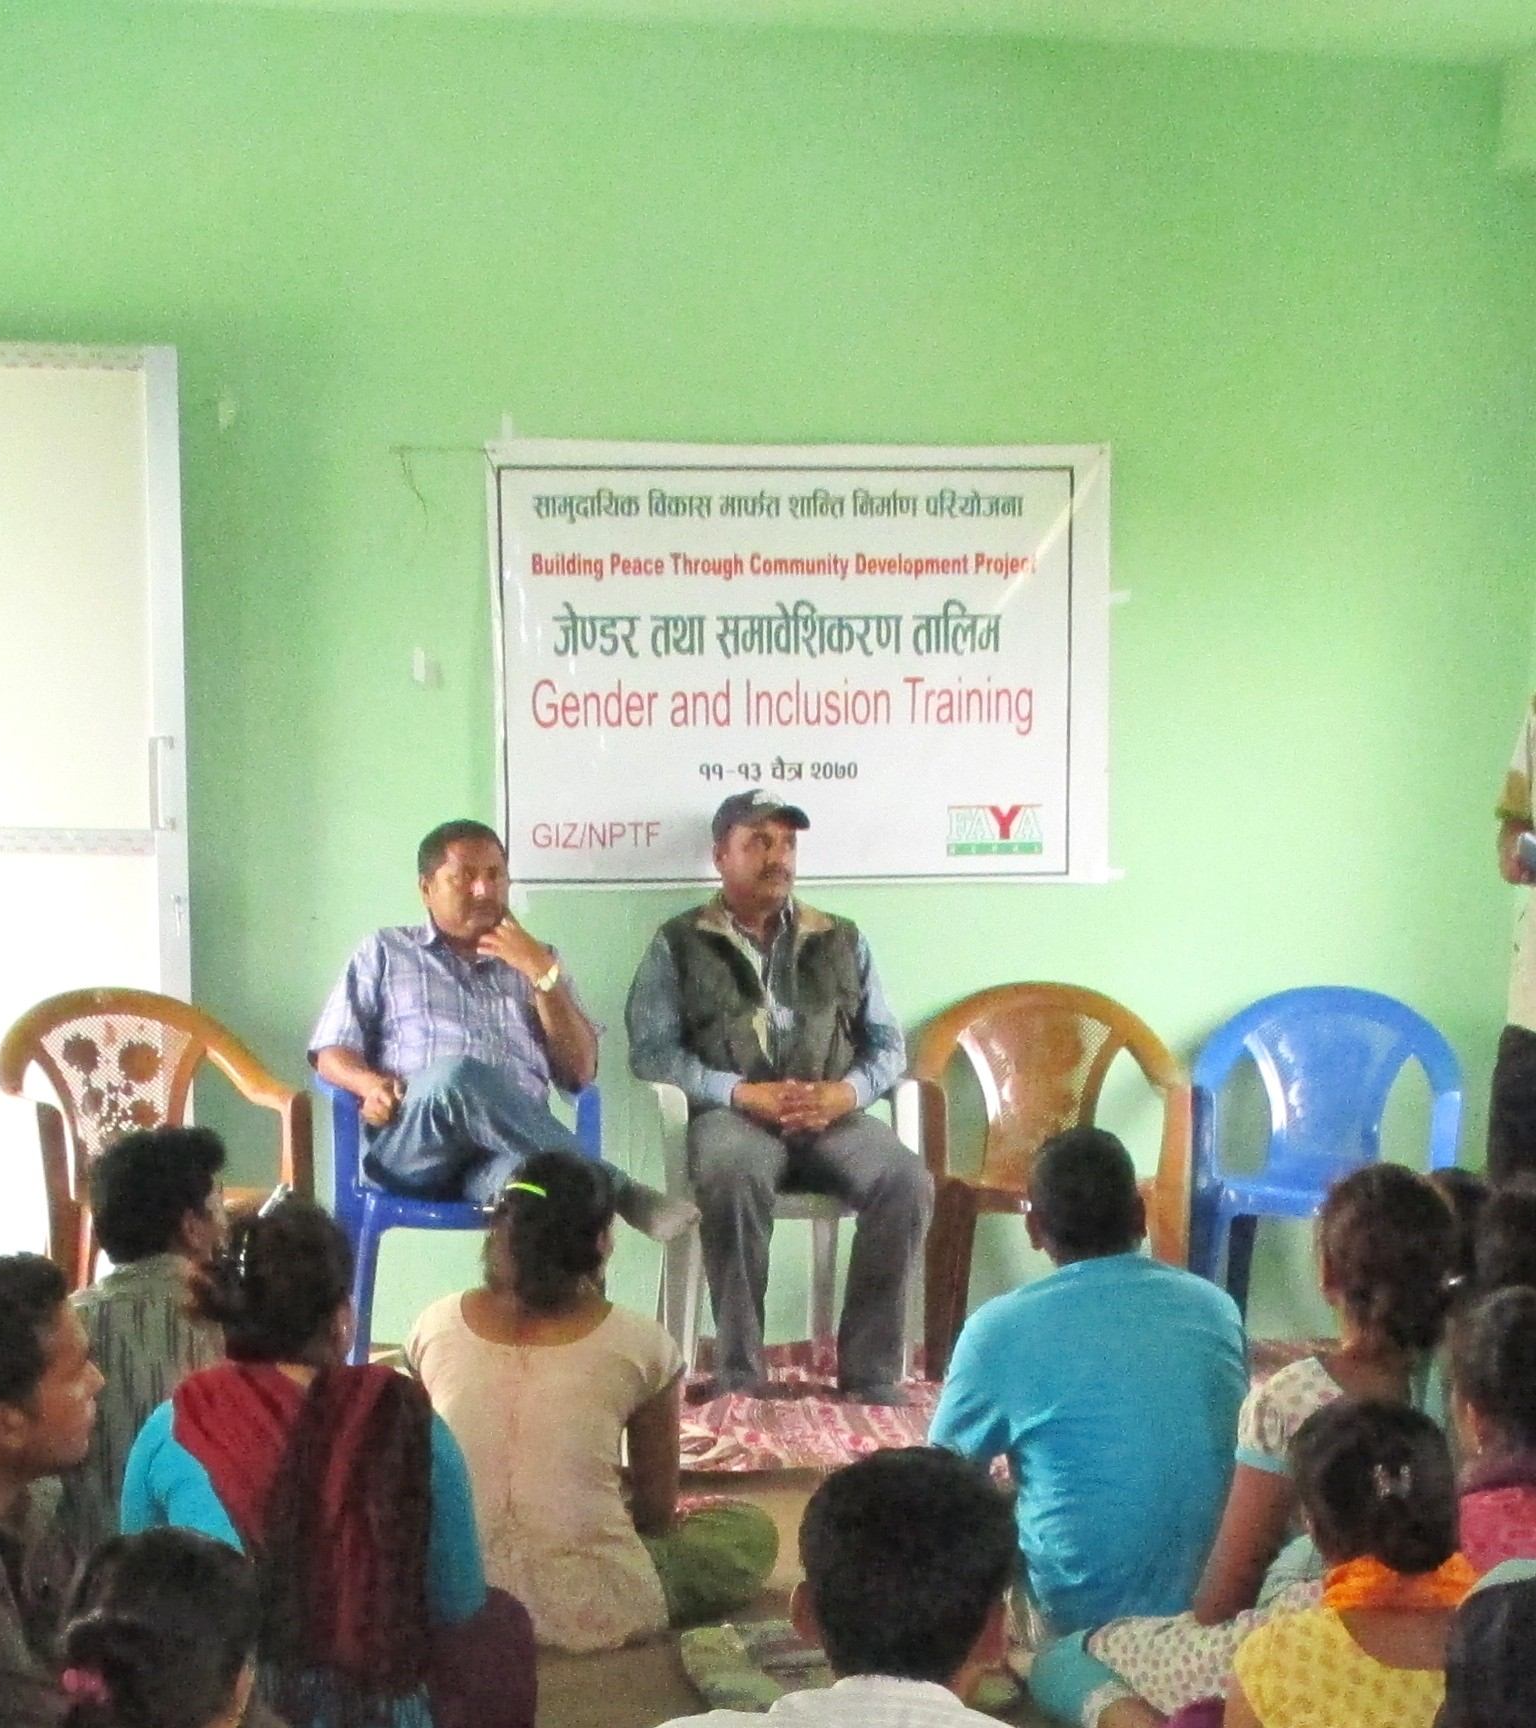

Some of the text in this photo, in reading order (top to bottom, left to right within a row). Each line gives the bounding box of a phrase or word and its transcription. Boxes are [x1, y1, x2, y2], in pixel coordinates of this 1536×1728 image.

[532, 487, 1024, 524] सामुदायिक विकास मार्फत शान्ति निर्माण परियोजना
[531, 552, 604, 582] Building
[610, 552, 664, 576] Peace
[669, 552, 743, 581] Through
[750, 552, 849, 580] Community
[855, 552, 968, 580] Development
[552, 598, 1002, 659] जेण्डर तथा समावेशिकरण तालिम
[532, 676, 1033, 736] Gender and Inclusion Training
[810, 761, 859, 780] २०७०
[532, 820, 661, 849] GIZ/NPTF
